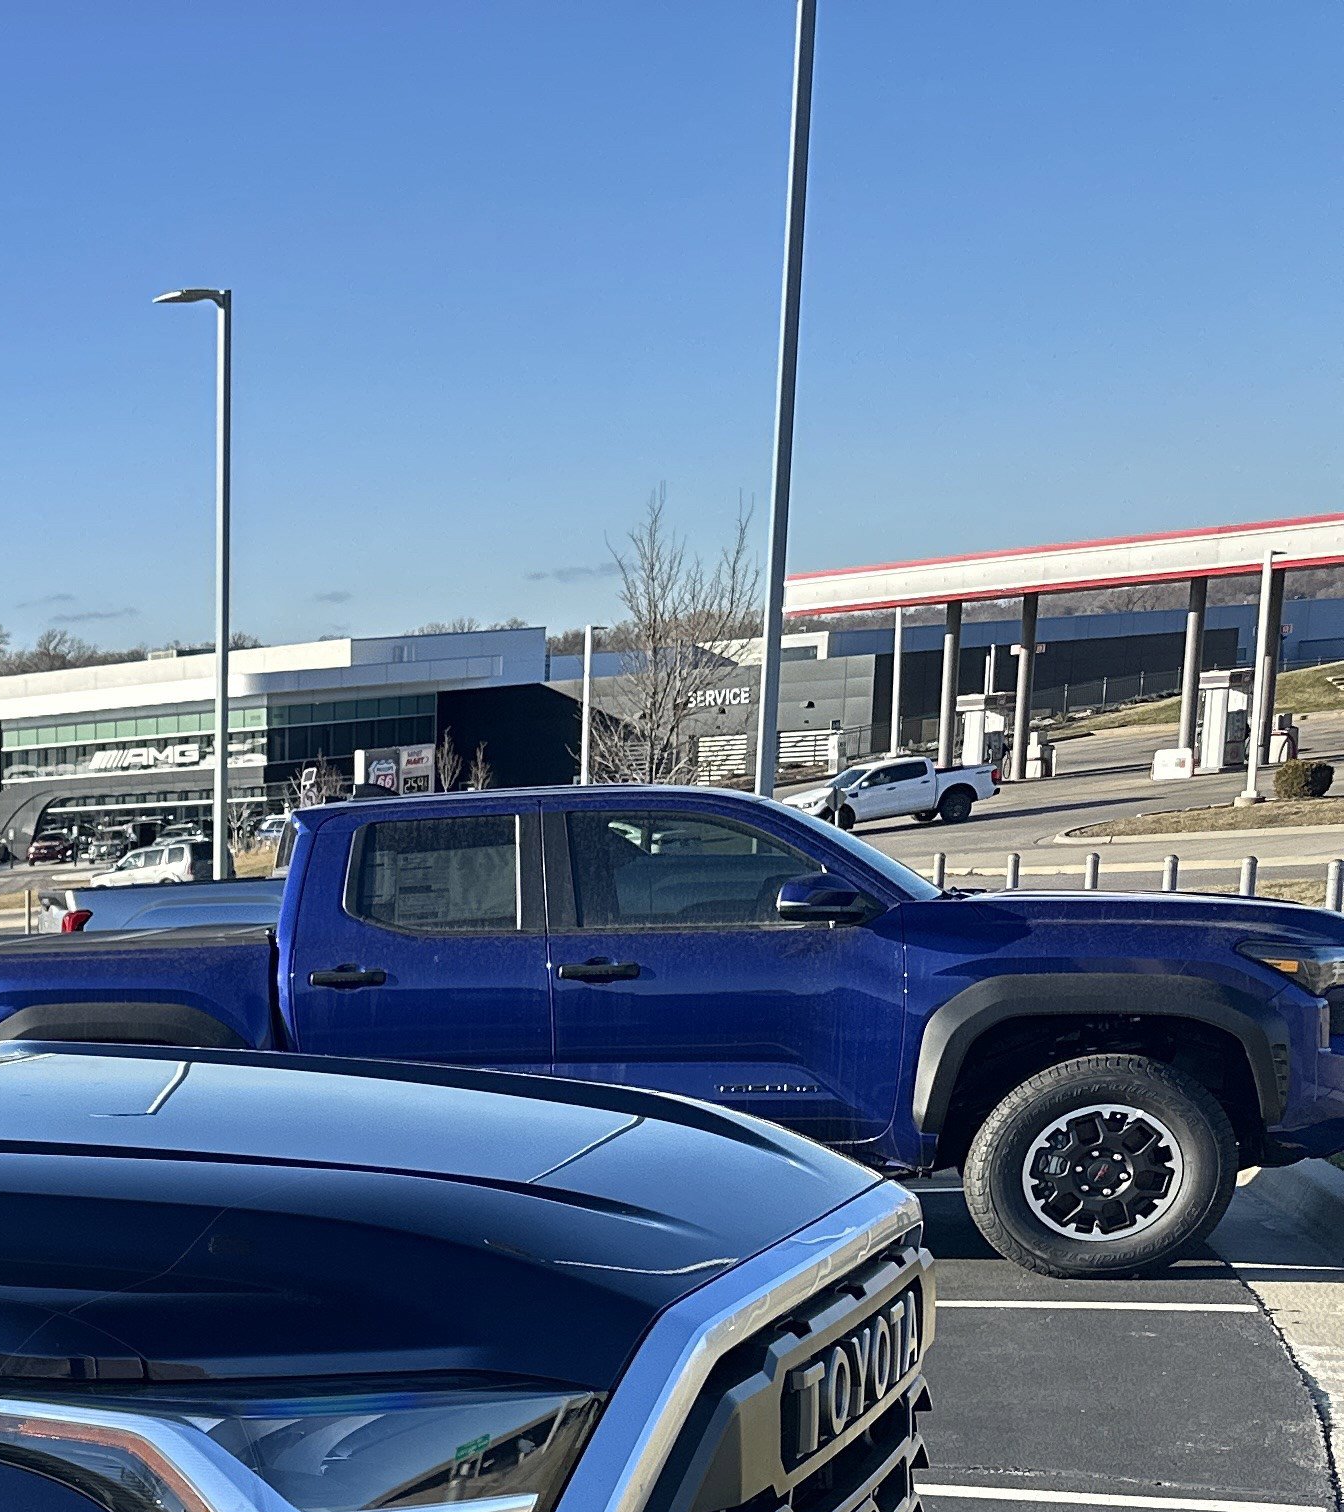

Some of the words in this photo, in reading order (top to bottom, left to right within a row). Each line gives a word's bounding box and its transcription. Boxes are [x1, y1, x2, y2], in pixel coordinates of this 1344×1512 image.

[687, 687, 750, 707] SERVICE
[121, 743, 200, 767] AMG
[793, 1290, 919, 1460] TOYOTA
